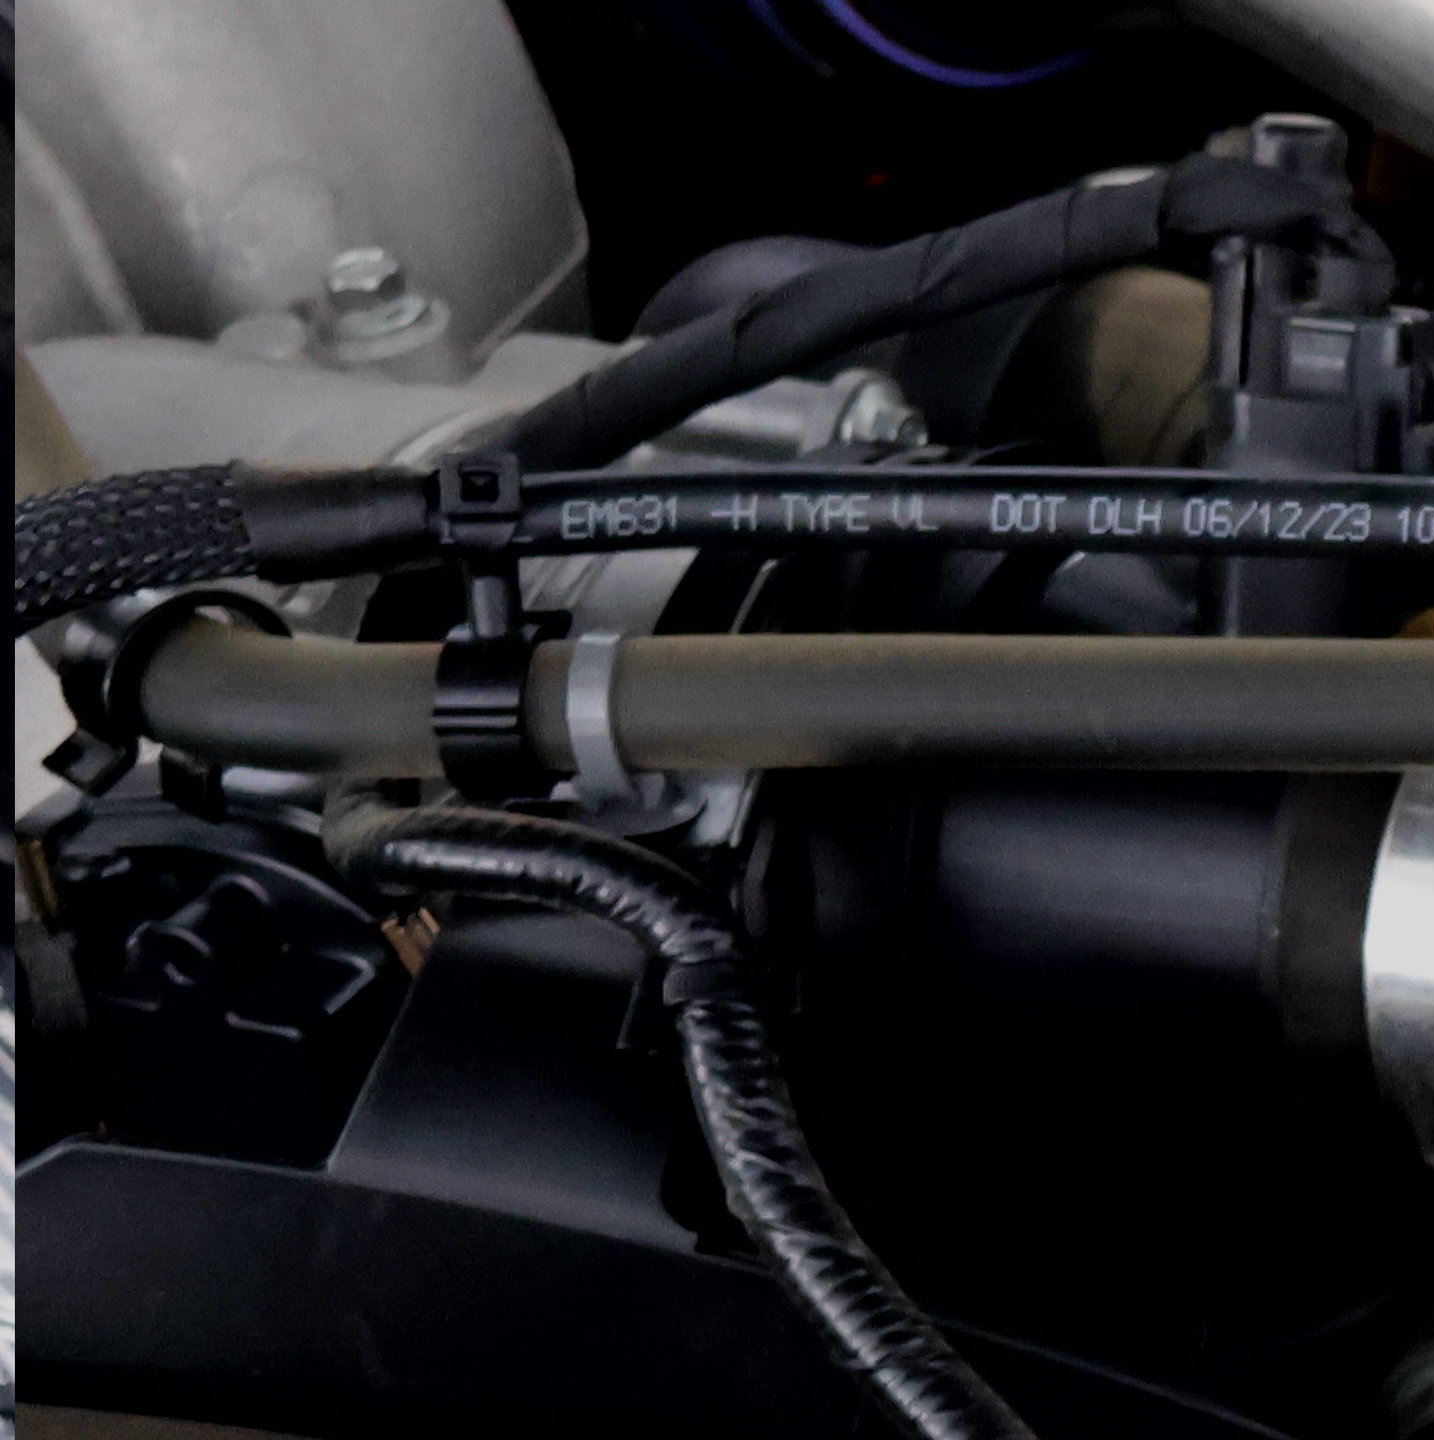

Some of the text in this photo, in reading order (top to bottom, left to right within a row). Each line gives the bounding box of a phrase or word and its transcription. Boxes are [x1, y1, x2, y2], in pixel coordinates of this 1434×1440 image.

[561, 495, 678, 540] EM631
[781, 493, 871, 533] TYPE
[990, 492, 1067, 534] DOT
[1183, 497, 1372, 542] 06/12/23
